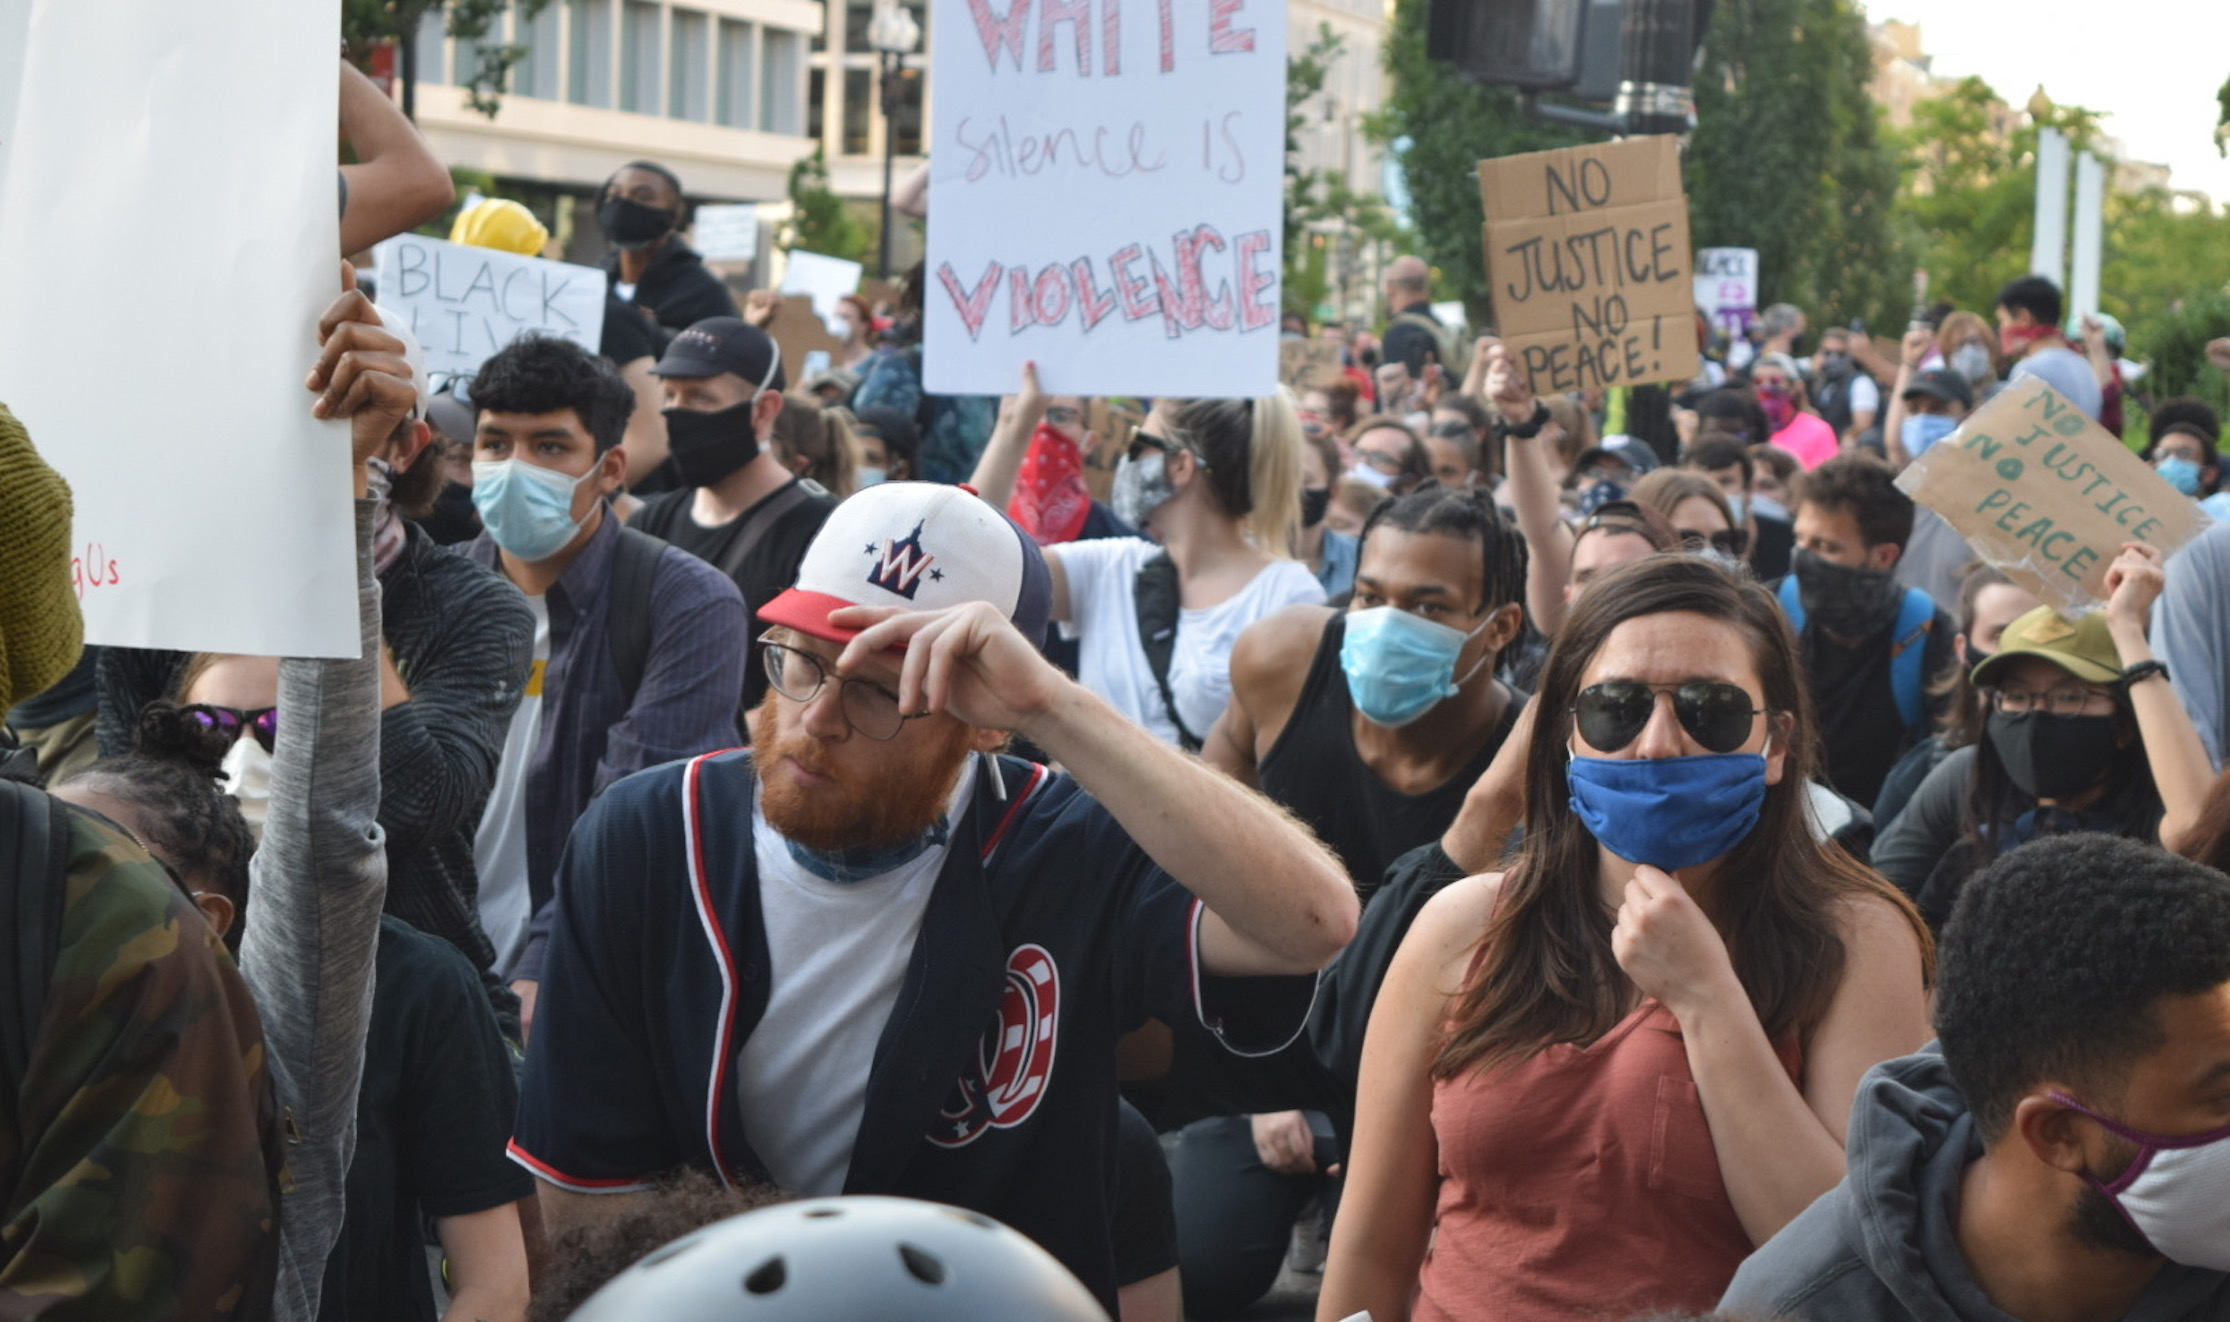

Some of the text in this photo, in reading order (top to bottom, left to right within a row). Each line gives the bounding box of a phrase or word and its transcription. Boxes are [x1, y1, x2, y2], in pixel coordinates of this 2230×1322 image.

[1546, 157, 1611, 216] NO
[399, 243, 579, 327] BLACK
[935, 223, 1276, 343] VIOLENCE
[1506, 222, 1680, 302] JUSTICE
[1522, 314, 1663, 394] PEACE!
[1571, 293, 1629, 342] NO
[2022, 389, 2087, 437] NO
[1963, 432, 2026, 481] NO
[2014, 423, 2164, 541] JUSTICE
[879, 538, 936, 591] W
[1974, 488, 2100, 581] PEACE
